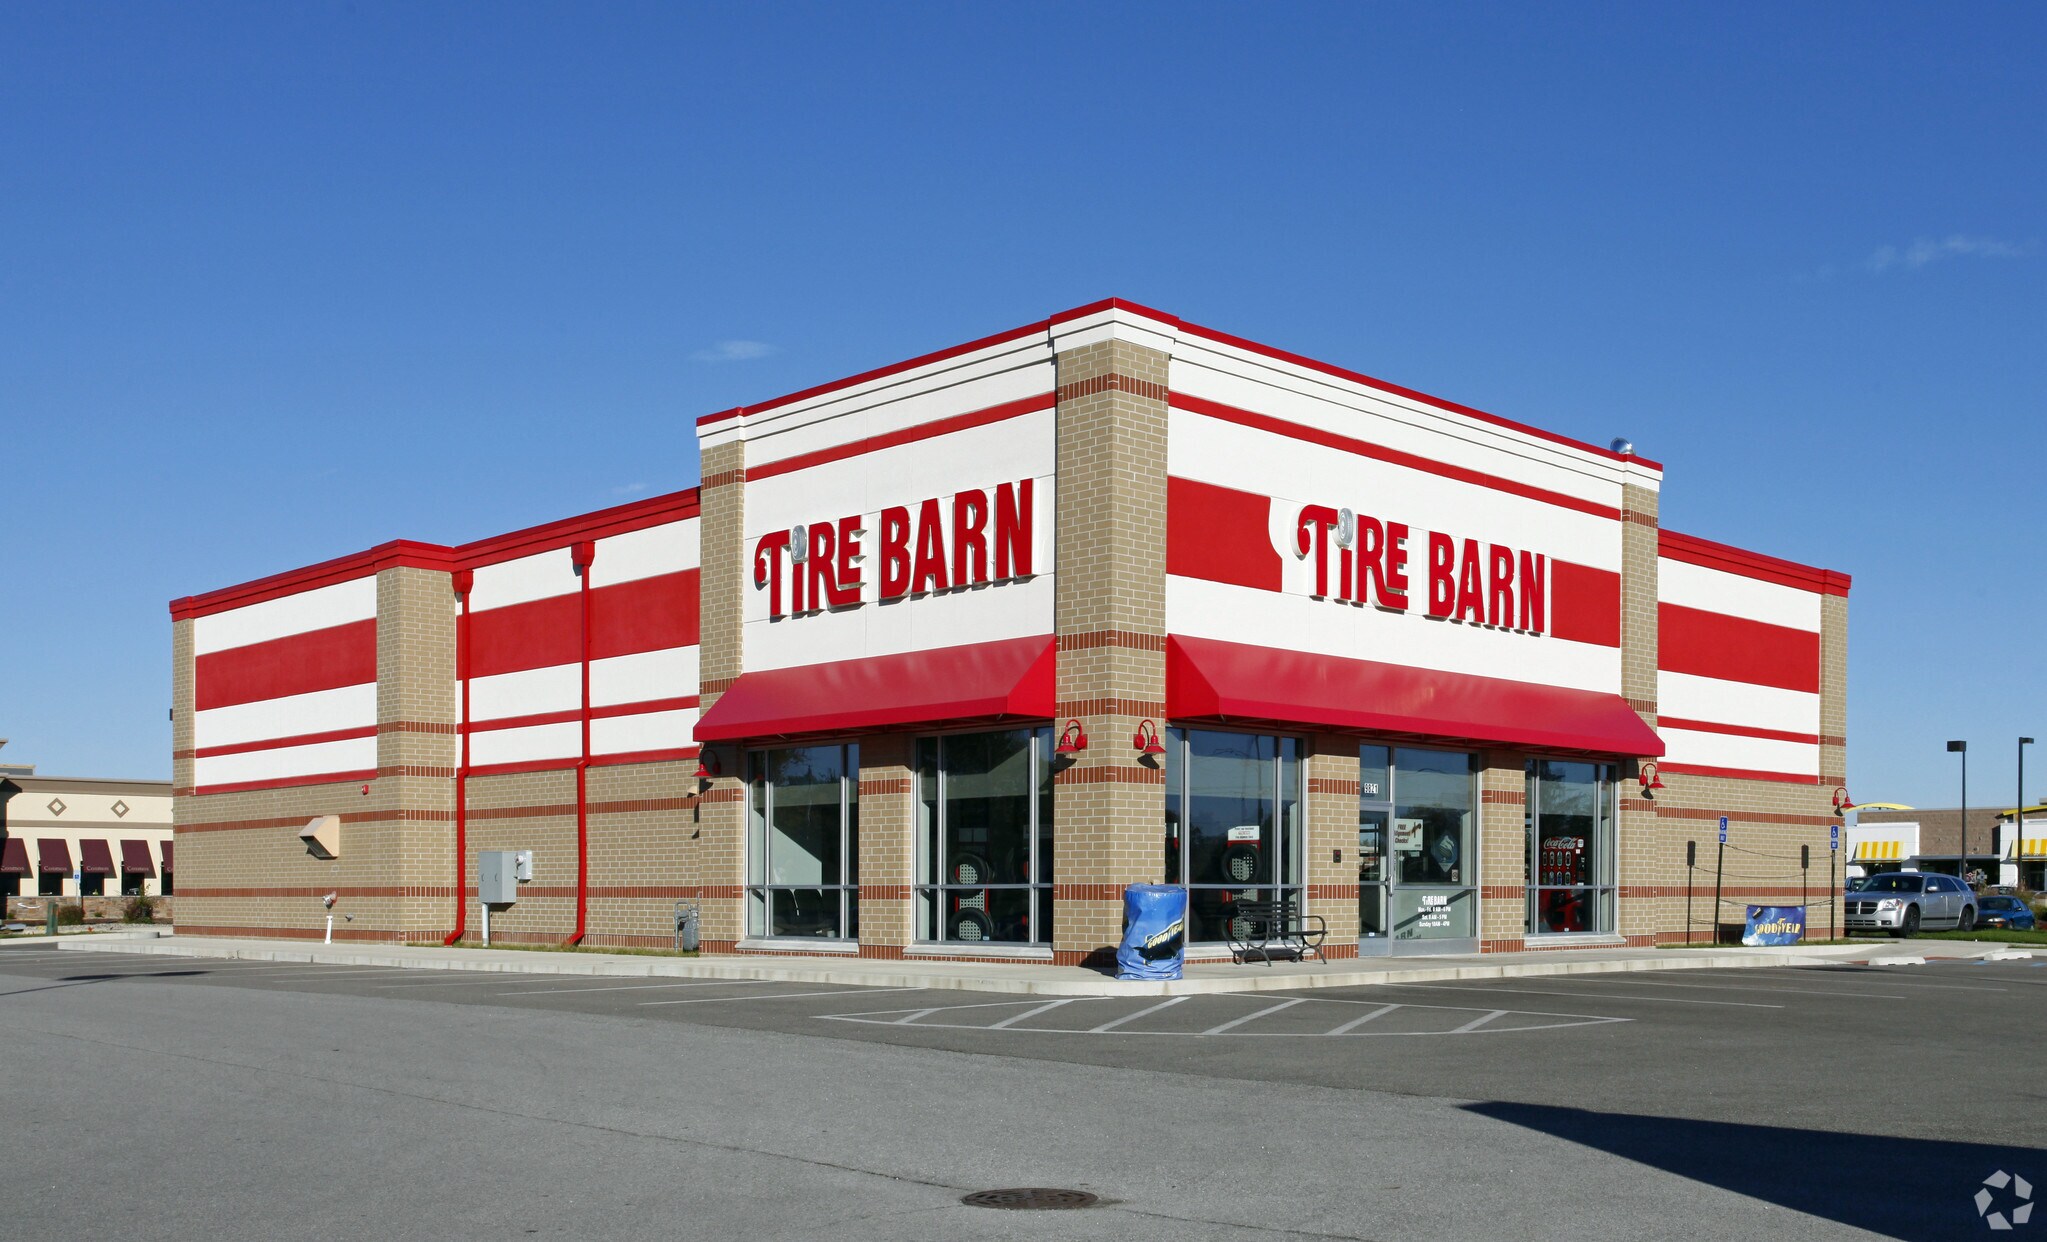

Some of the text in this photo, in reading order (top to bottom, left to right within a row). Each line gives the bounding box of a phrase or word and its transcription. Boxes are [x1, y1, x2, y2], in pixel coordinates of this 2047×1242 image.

[754, 478, 1034, 621] TIRE BARN
[1297, 504, 1545, 635] TIRE BARN
[1434, 895, 1447, 905] BARN
